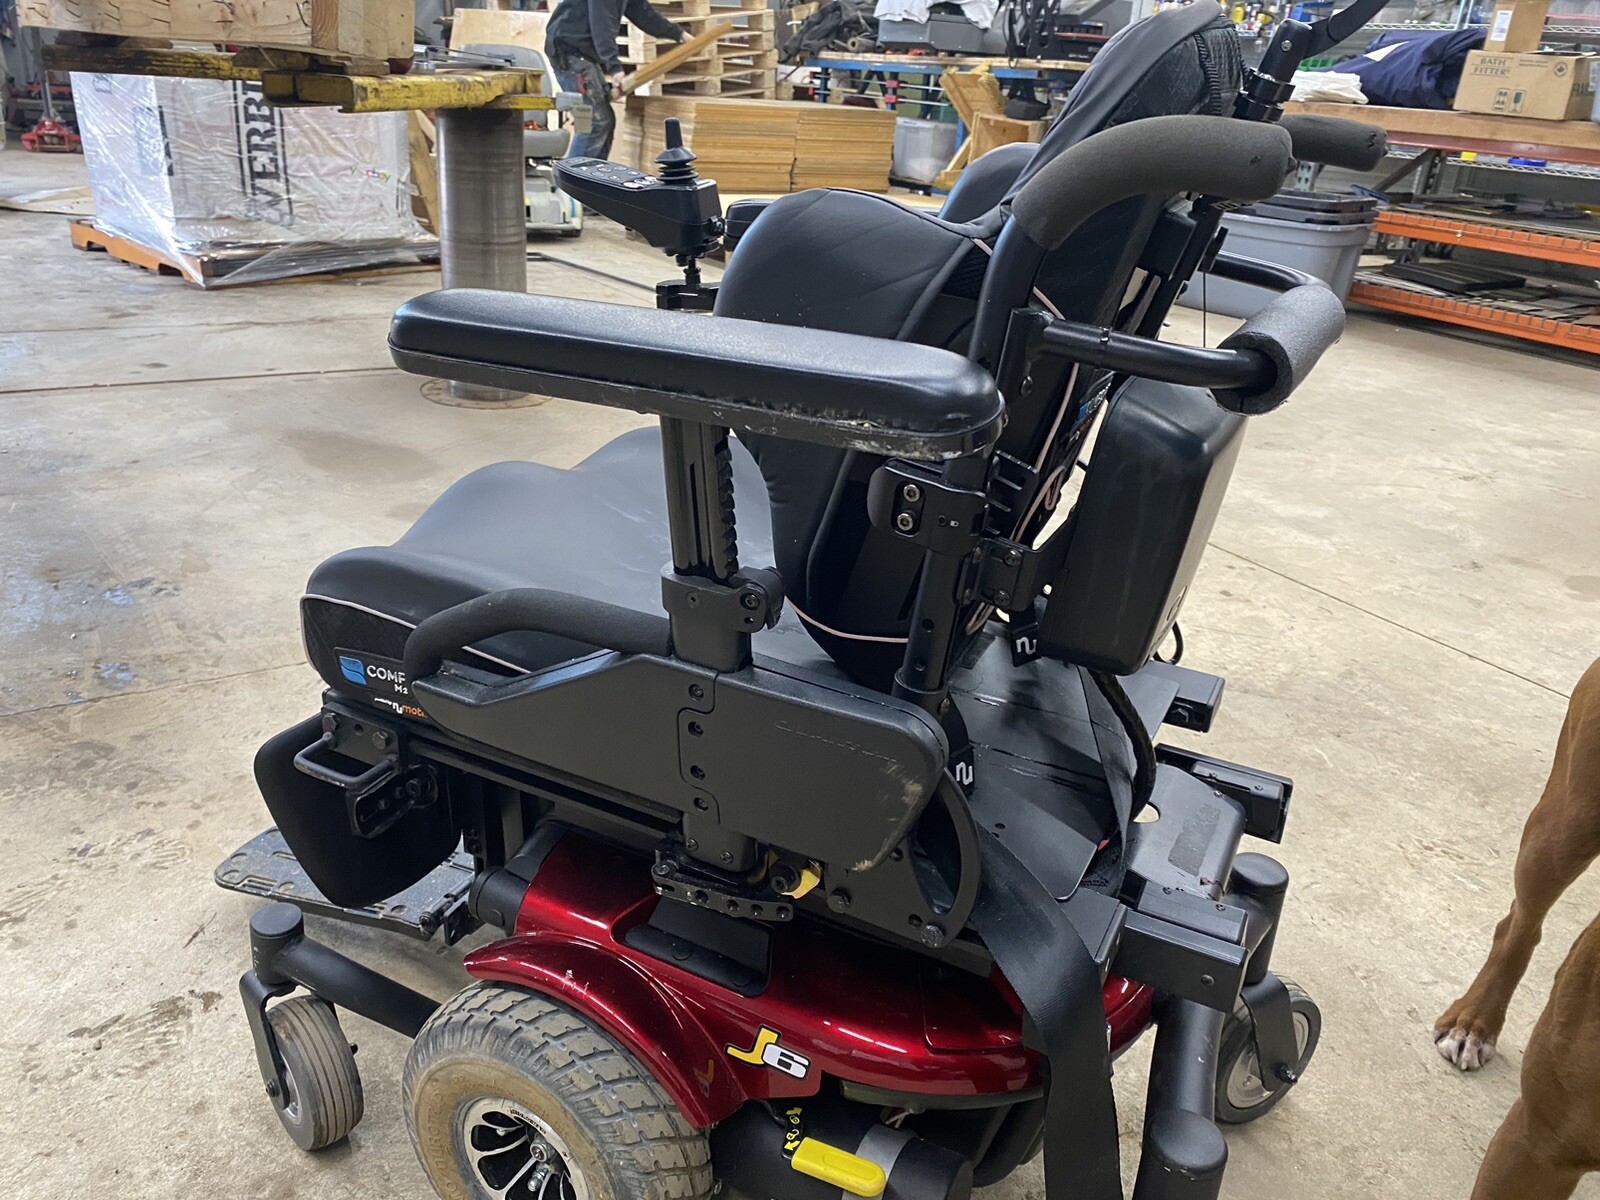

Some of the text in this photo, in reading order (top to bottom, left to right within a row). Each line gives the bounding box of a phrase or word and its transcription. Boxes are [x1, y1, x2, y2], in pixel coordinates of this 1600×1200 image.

[1480, 57, 1506, 66] BATH
[394, 683, 408, 695] M2
[726, 1026, 810, 1079] J6
